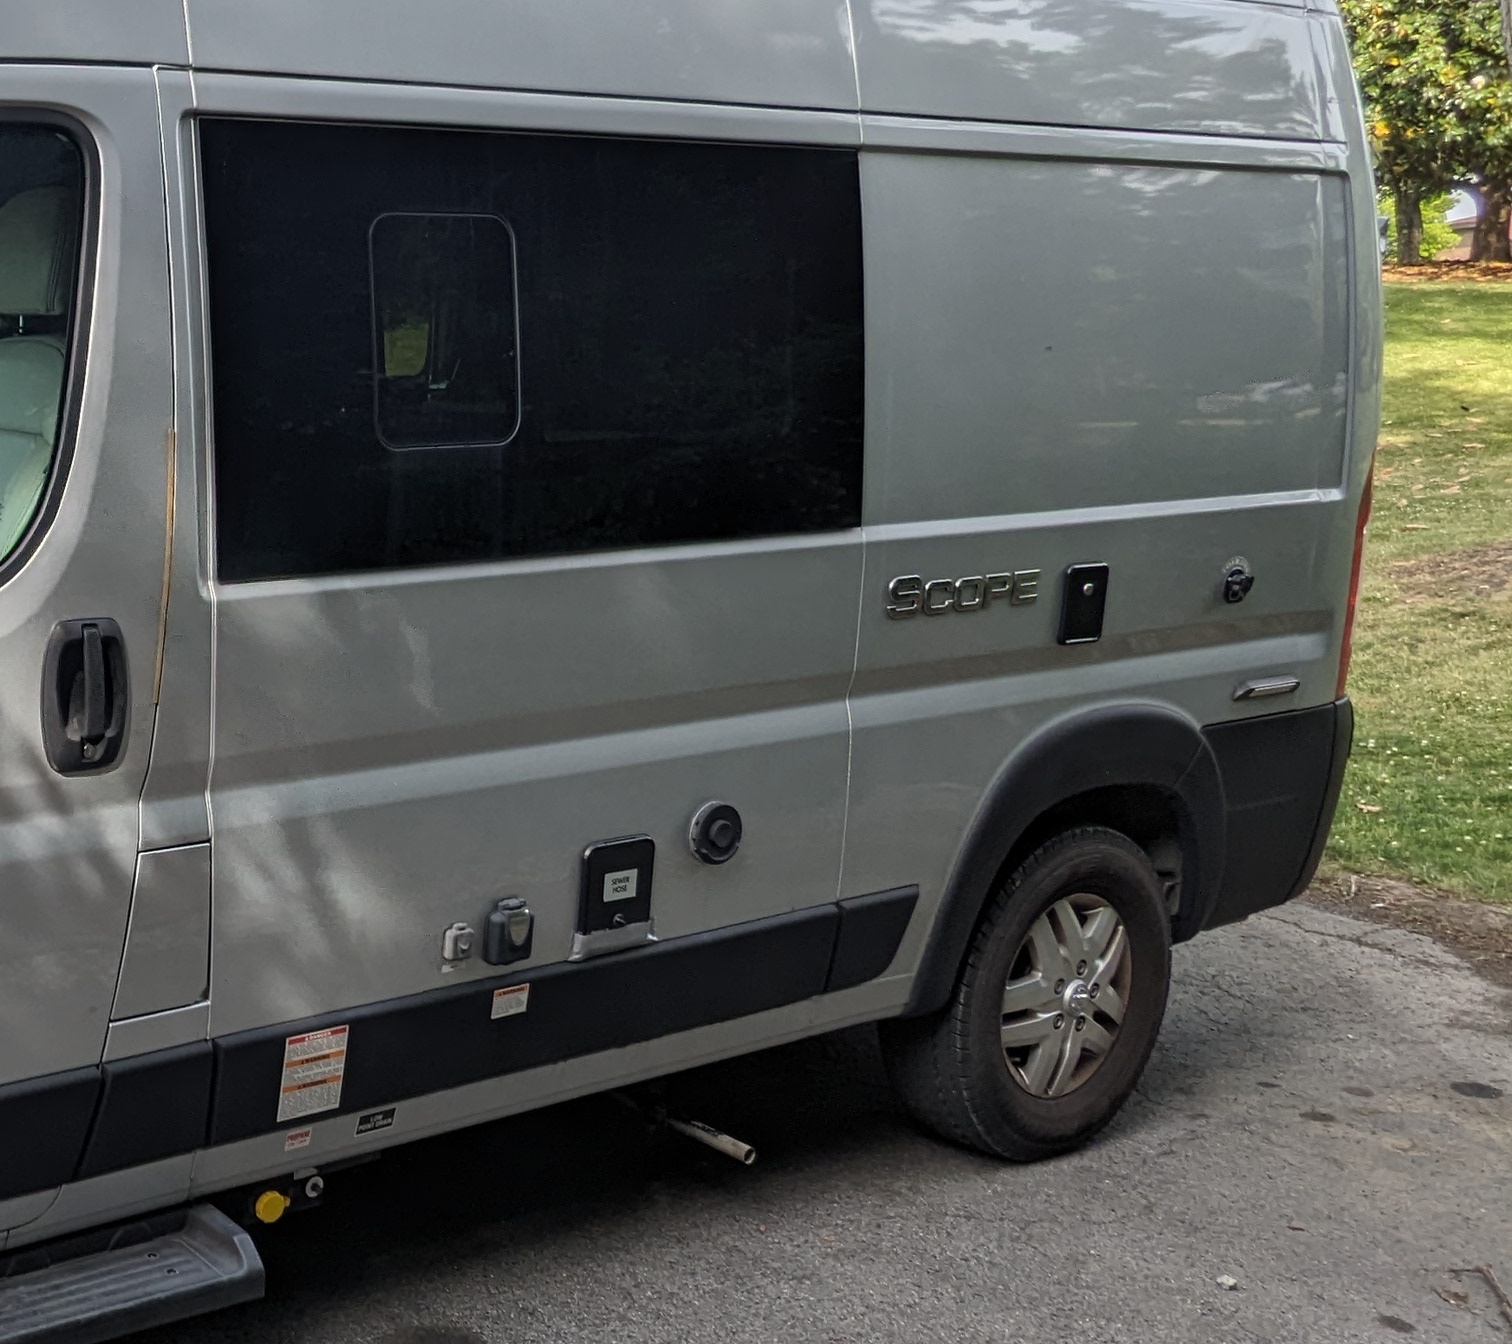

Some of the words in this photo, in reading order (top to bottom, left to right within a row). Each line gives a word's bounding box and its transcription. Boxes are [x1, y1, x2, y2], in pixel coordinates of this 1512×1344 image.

[886, 568, 1041, 619] SCOPE
[611, 876, 630, 885] SEWER
[612, 885, 628, 894] HOSE
